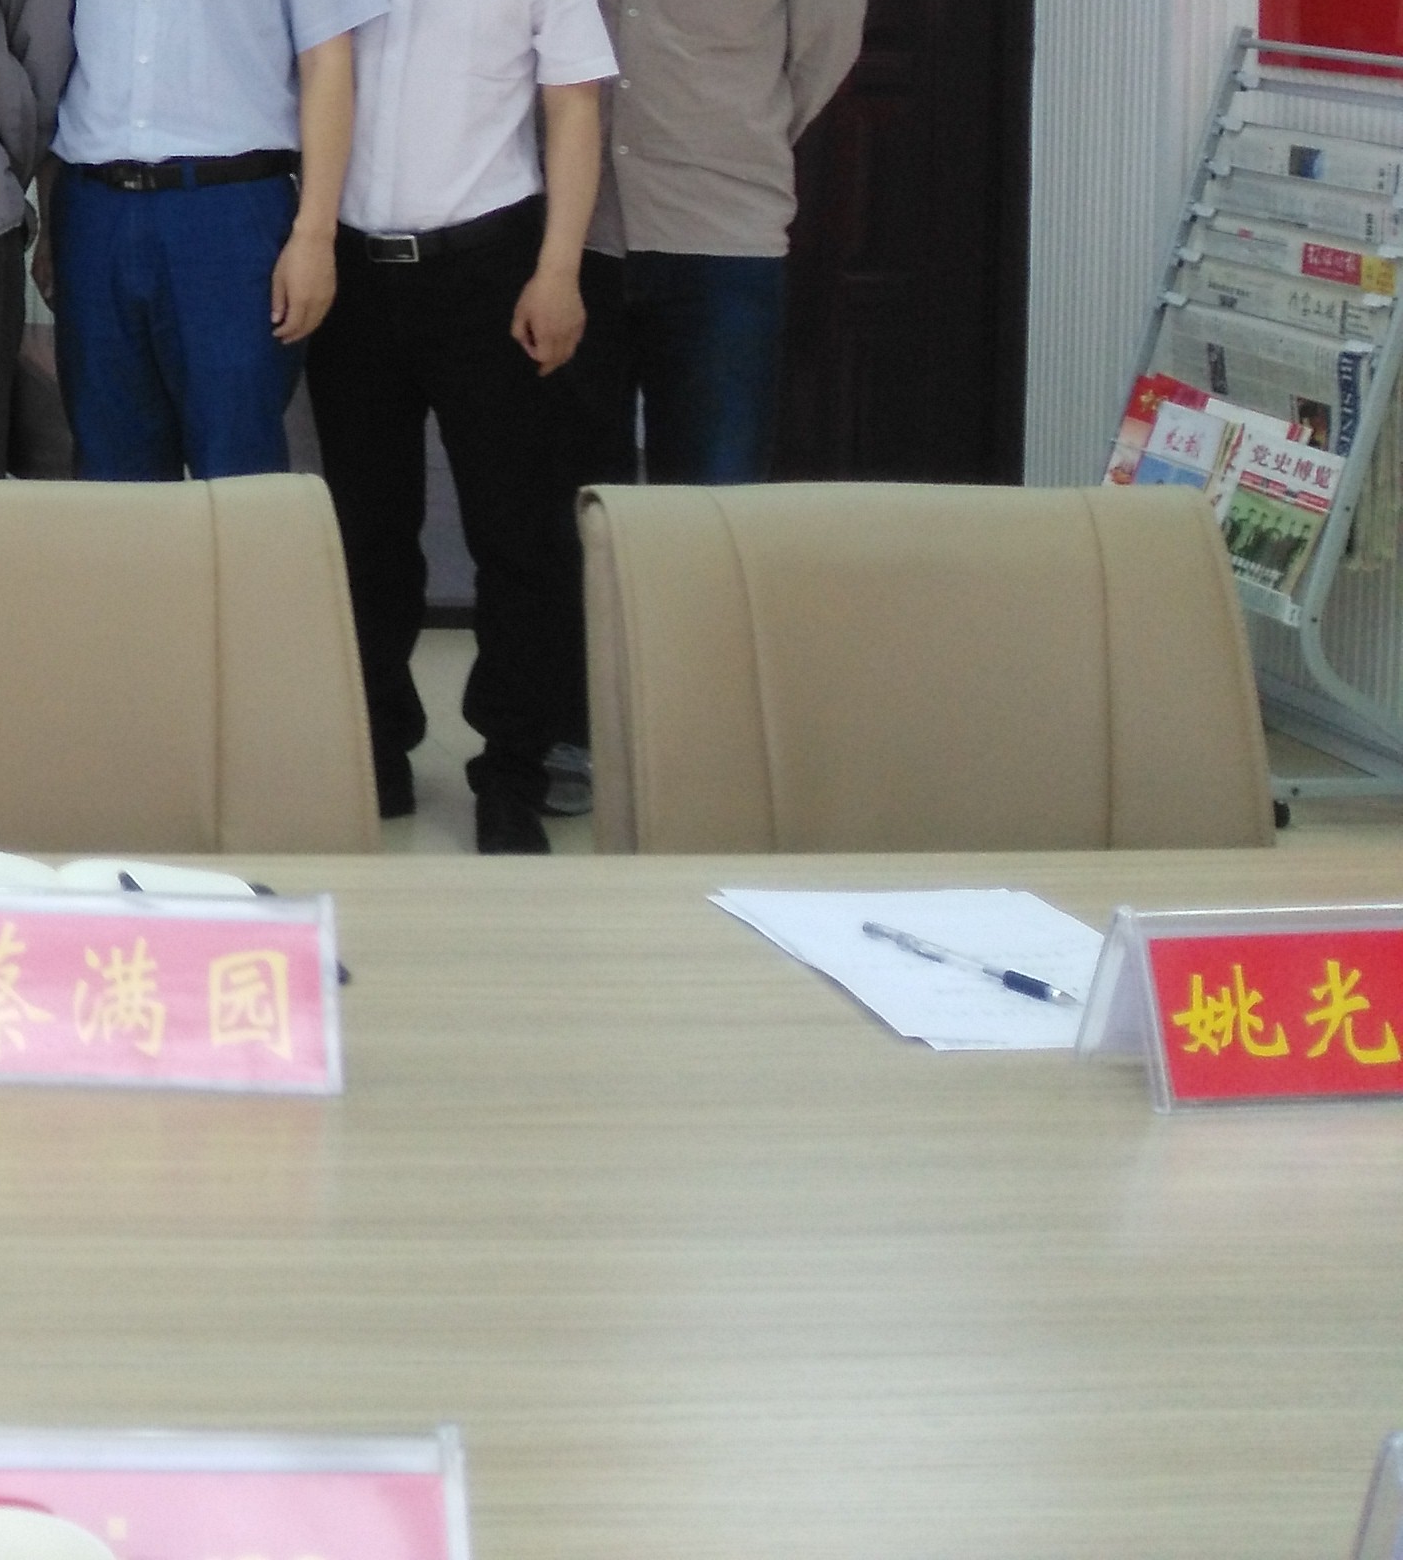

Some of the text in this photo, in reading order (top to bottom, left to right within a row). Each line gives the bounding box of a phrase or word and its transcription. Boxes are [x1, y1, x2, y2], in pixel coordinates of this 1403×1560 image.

[1251, 443, 1333, 490] 党史博览
[1172, 959, 1403, 1065] 姚光
